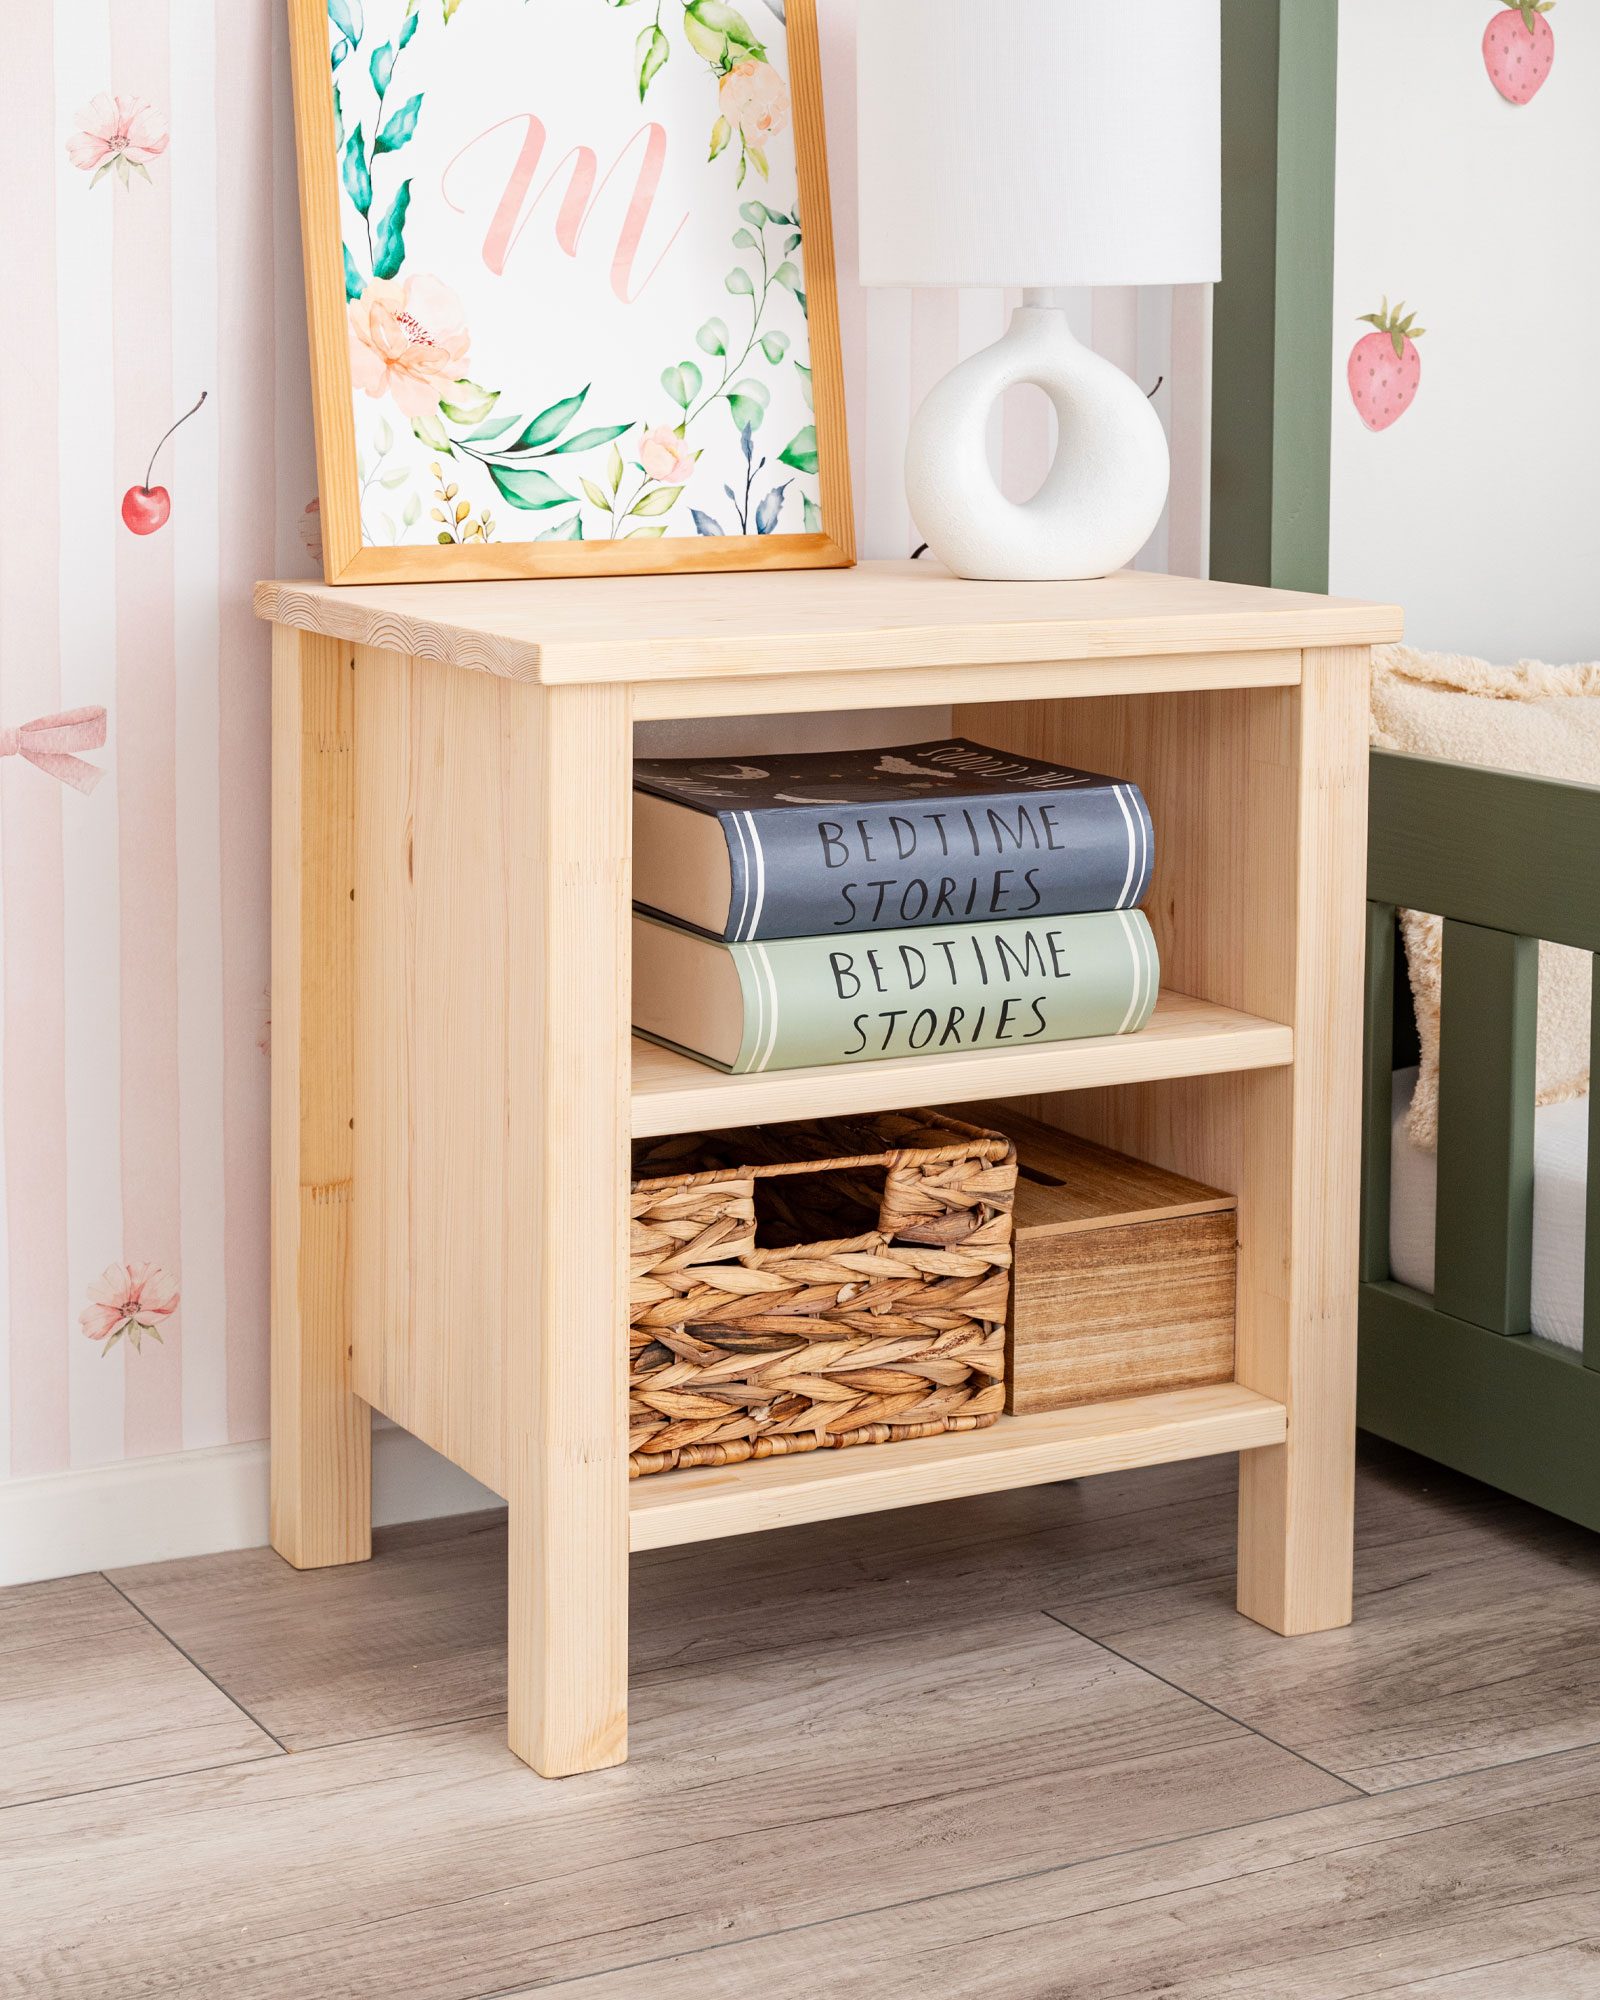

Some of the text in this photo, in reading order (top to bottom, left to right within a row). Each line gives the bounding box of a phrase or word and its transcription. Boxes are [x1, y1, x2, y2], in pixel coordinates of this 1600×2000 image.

[917, 747, 1091, 788] THE CLOUDS
[818, 805, 1065, 868] BEDTIME
[834, 868, 1040, 926] STORIES
[829, 931, 1071, 999] BEDTIME
[844, 996, 1047, 1055] STORIES
